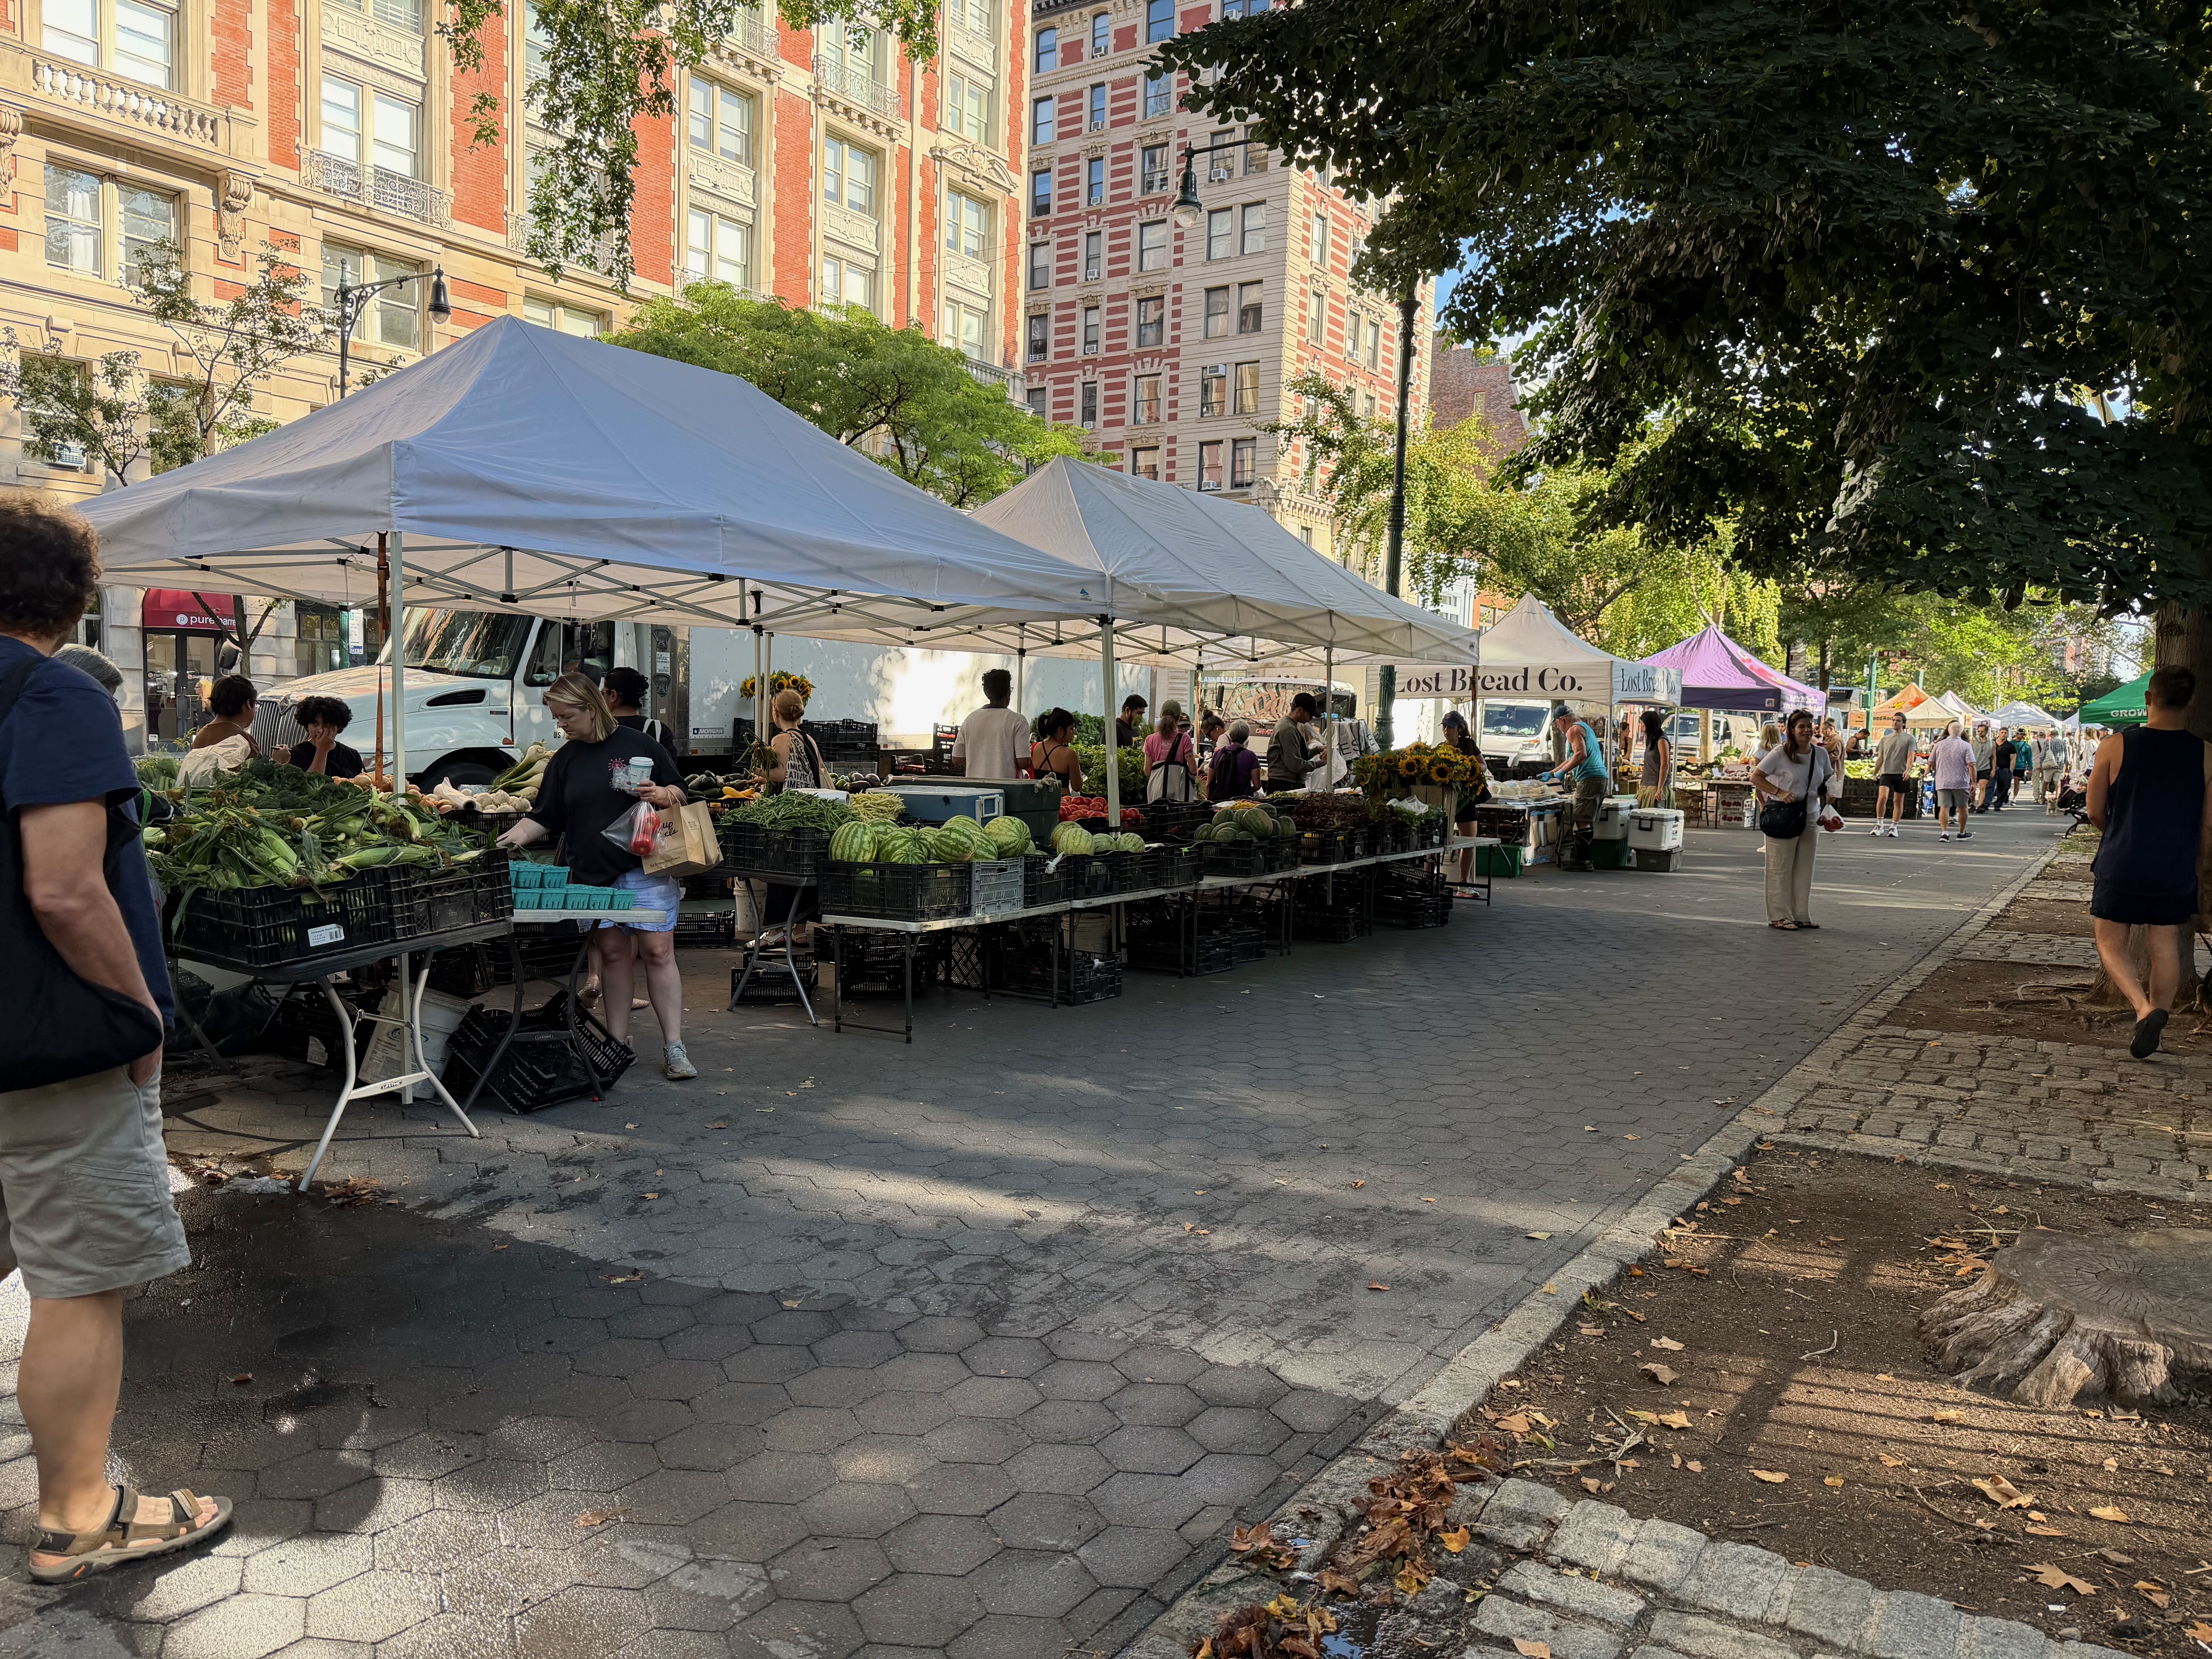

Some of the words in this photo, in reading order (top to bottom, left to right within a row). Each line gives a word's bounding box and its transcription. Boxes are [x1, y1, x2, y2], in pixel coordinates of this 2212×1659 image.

[190, 616, 215, 625] pure
[1395, 671, 1443, 693] Lost
[1538, 667, 1583, 691] Co.
[1621, 668, 1641, 692] Lost
[1642, 669, 1664, 693] Bread
[1666, 672, 1676, 695] Co.
[2110, 709, 2147, 717] GROW
